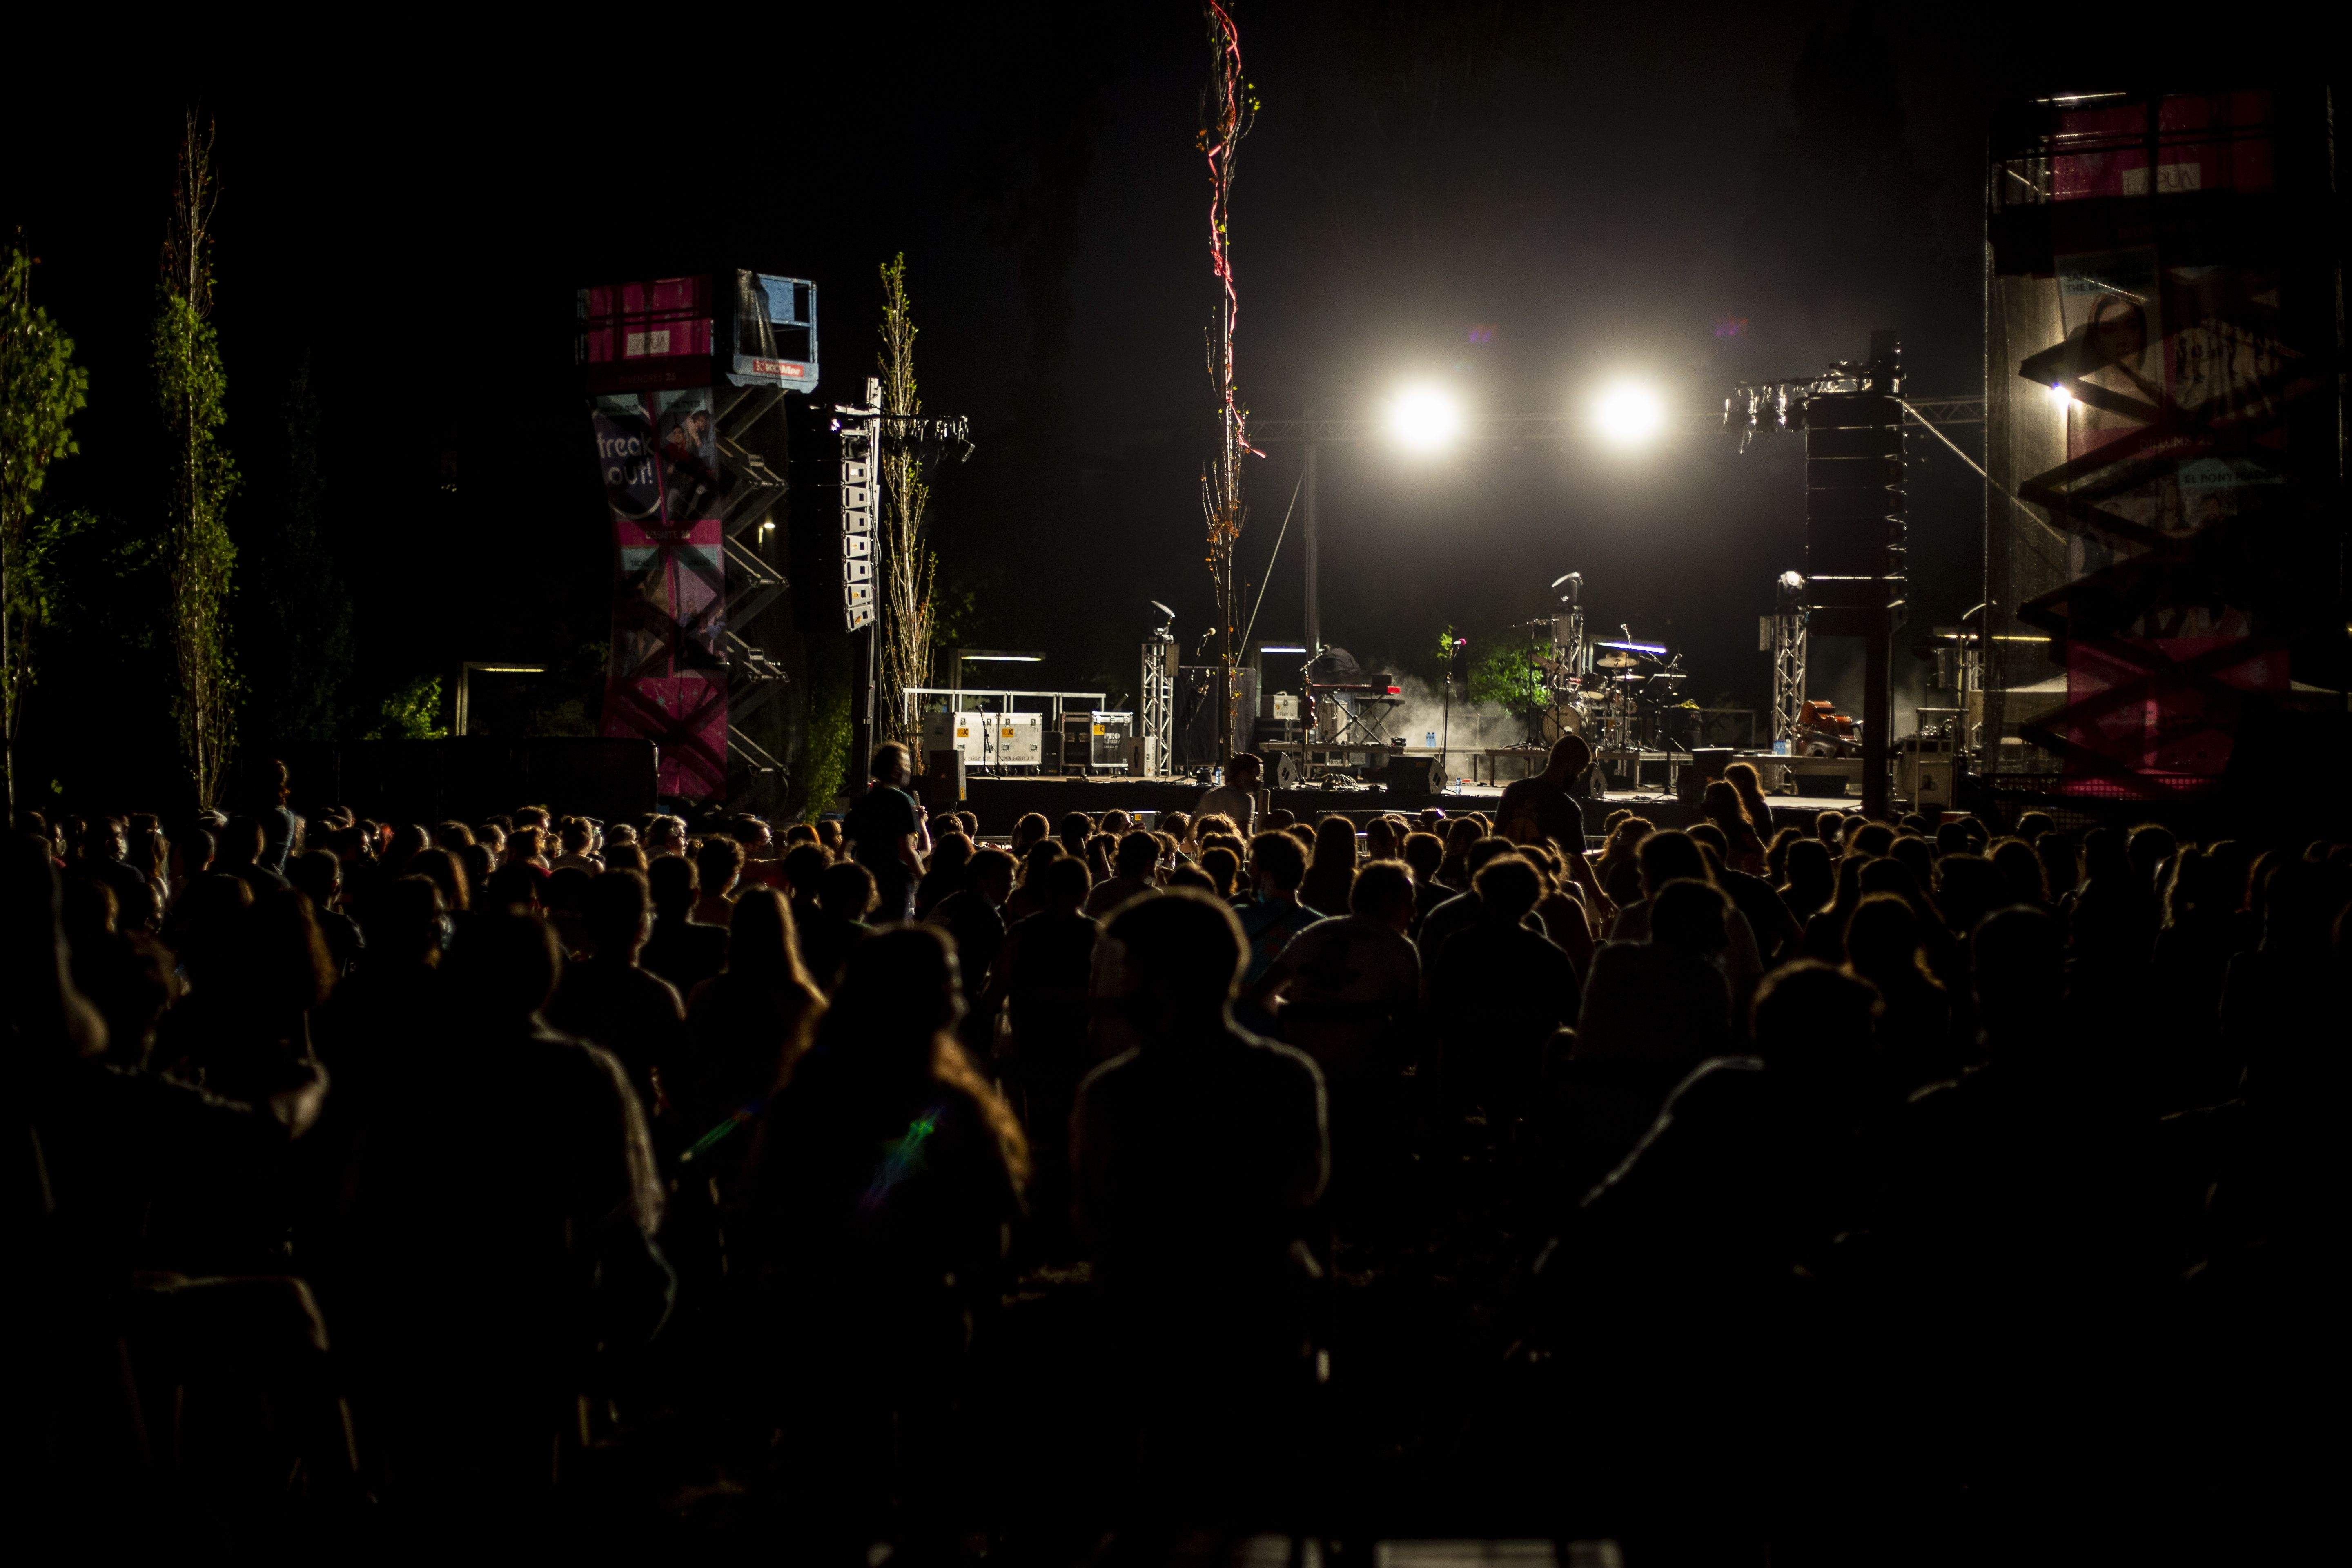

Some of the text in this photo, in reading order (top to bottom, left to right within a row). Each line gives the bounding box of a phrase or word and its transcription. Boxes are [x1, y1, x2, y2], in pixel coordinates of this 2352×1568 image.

[598, 432, 653, 458] freak
[608, 456, 653, 485] out!
[2184, 475, 2196, 484] EL
[2200, 472, 2232, 483] PONY
